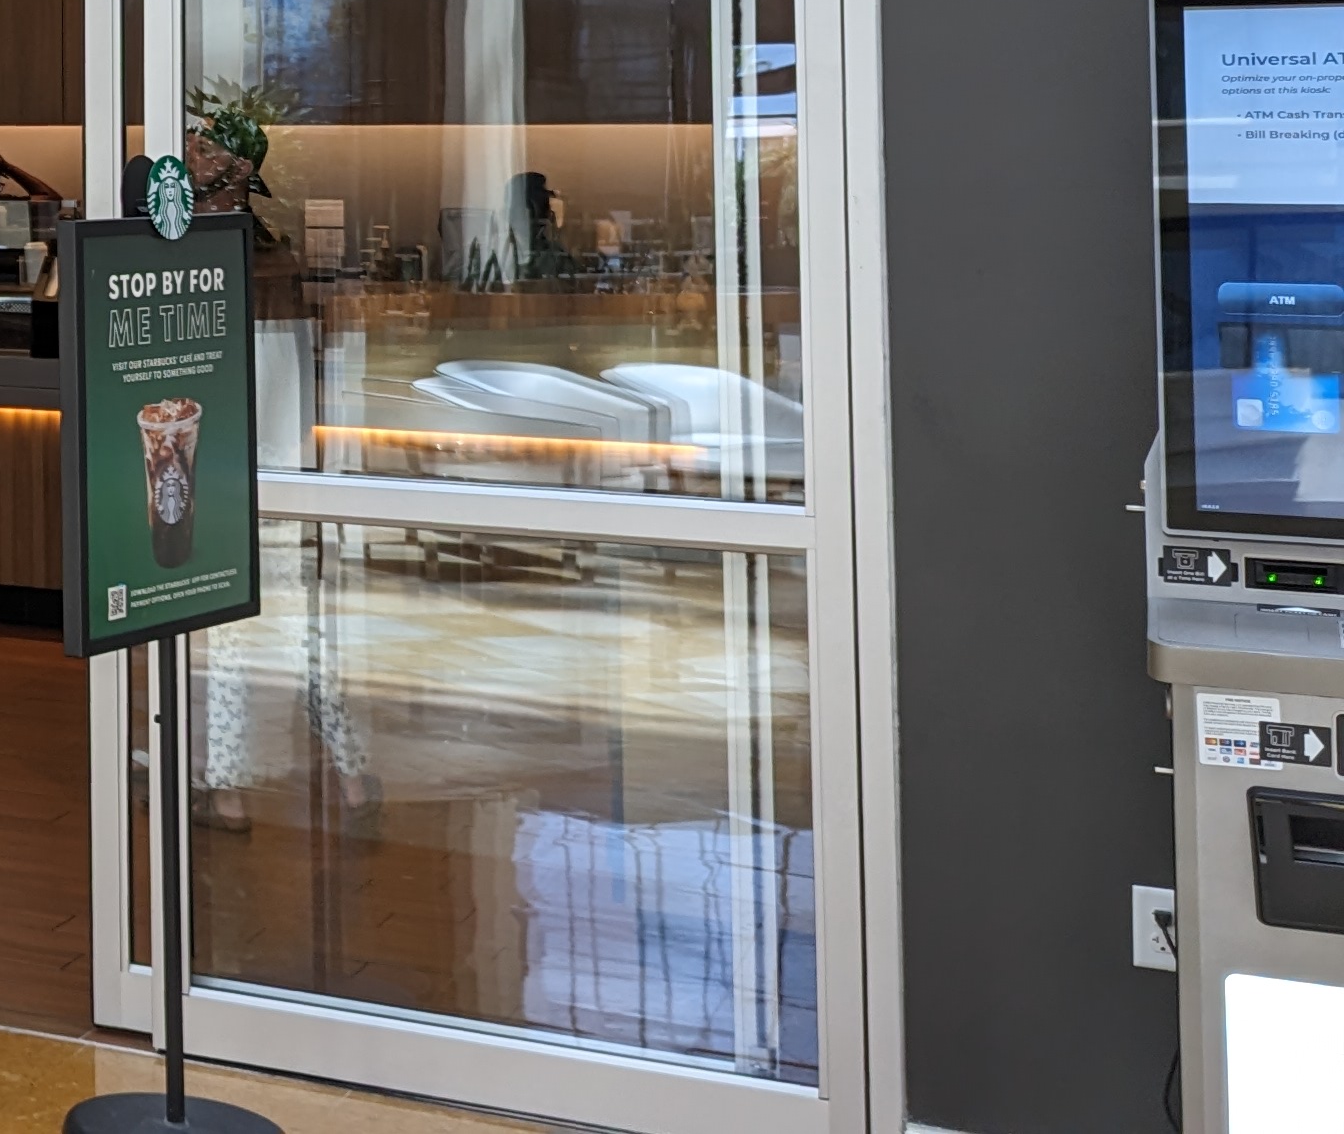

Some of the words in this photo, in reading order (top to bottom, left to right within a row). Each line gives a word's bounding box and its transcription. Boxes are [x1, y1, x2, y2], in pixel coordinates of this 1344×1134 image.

[1221, 51, 1317, 67] Universal
[1221, 74, 1270, 83] Optimize
[1271, 76, 1297, 84] your
[1221, 87, 1262, 95] options
[1263, 87, 1275, 95] at
[1278, 86, 1298, 94] this
[1244, 110, 1273, 119] ATM
[1277, 110, 1310, 119] Cash
[1245, 130, 1266, 139] Bill
[1269, 130, 1330, 141] Breaking
[108, 272, 157, 300] STOP
[162, 270, 184, 295] BY
[189, 267, 224, 293] FOR
[1269, 295, 1295, 305] ATM
[108, 306, 151, 348] ME
[159, 299, 226, 342] TIME
[112, 361, 128, 372] VISIT
[122, 371, 152, 383] YOURSELF
[153, 370, 162, 379] TO
[162, 365, 196, 378] SOMETHING
[196, 363, 214, 374] GOOD
